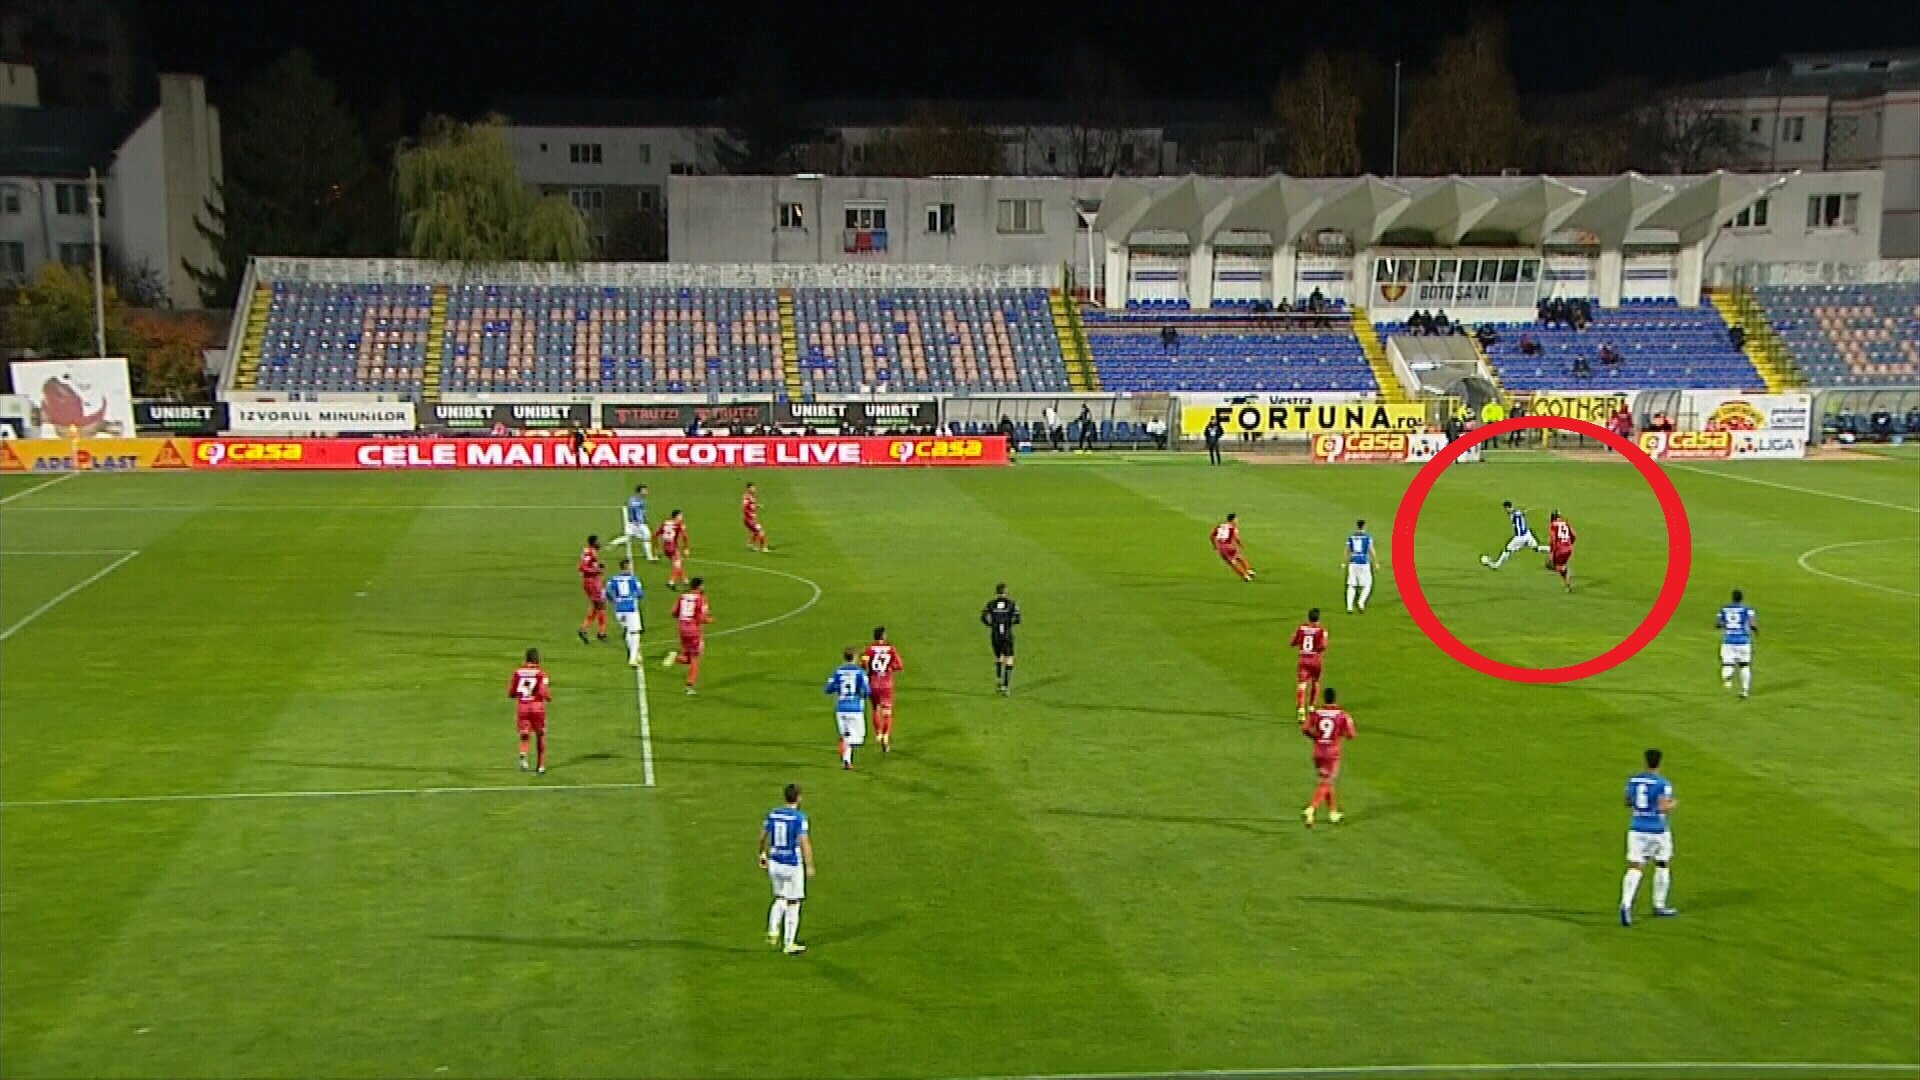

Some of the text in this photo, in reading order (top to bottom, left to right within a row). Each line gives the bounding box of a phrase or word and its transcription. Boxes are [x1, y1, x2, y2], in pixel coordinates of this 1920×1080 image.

[151, 406, 213, 420] UNIBET
[240, 411, 406, 421] IZVORUL MINUNILOR
[435, 405, 495, 419] UNIBET
[513, 405, 571, 419] UNIBET
[791, 403, 848, 417] UNIBET
[865, 403, 920, 417] UNIBET
[1346, 433, 1404, 451] casa
[1668, 431, 1729, 448] casa
[227, 443, 303, 461] casa
[357, 442, 861, 466] CELE MAI MARI COTE LIVE
[915, 441, 983, 457] casa
[1318, 717, 1336, 739] 9
